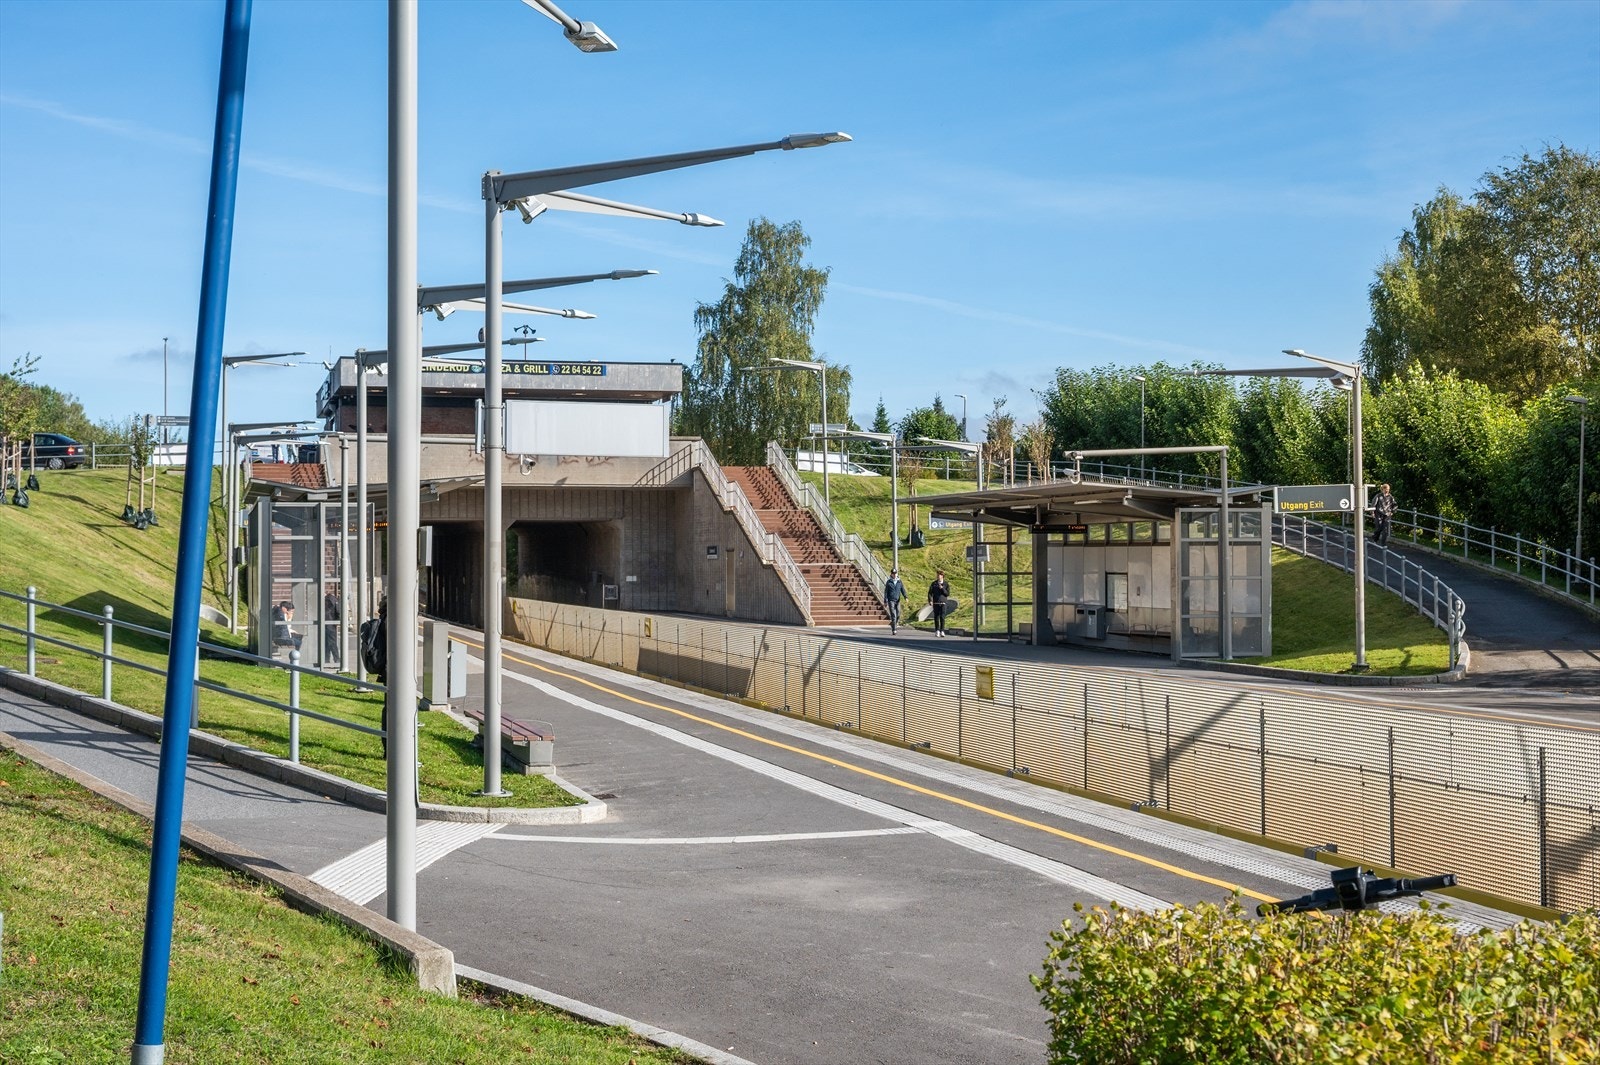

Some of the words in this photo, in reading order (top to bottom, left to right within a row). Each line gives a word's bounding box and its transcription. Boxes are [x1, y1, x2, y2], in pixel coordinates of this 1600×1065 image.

[514, 365, 520, 373] &
[523, 365, 548, 373] GRILL
[561, 365, 570, 374] 22
[572, 366, 580, 374] 64
[582, 366, 591, 374] 54
[1280, 501, 1308, 510] Utgang
[1309, 500, 1324, 508] Exit
